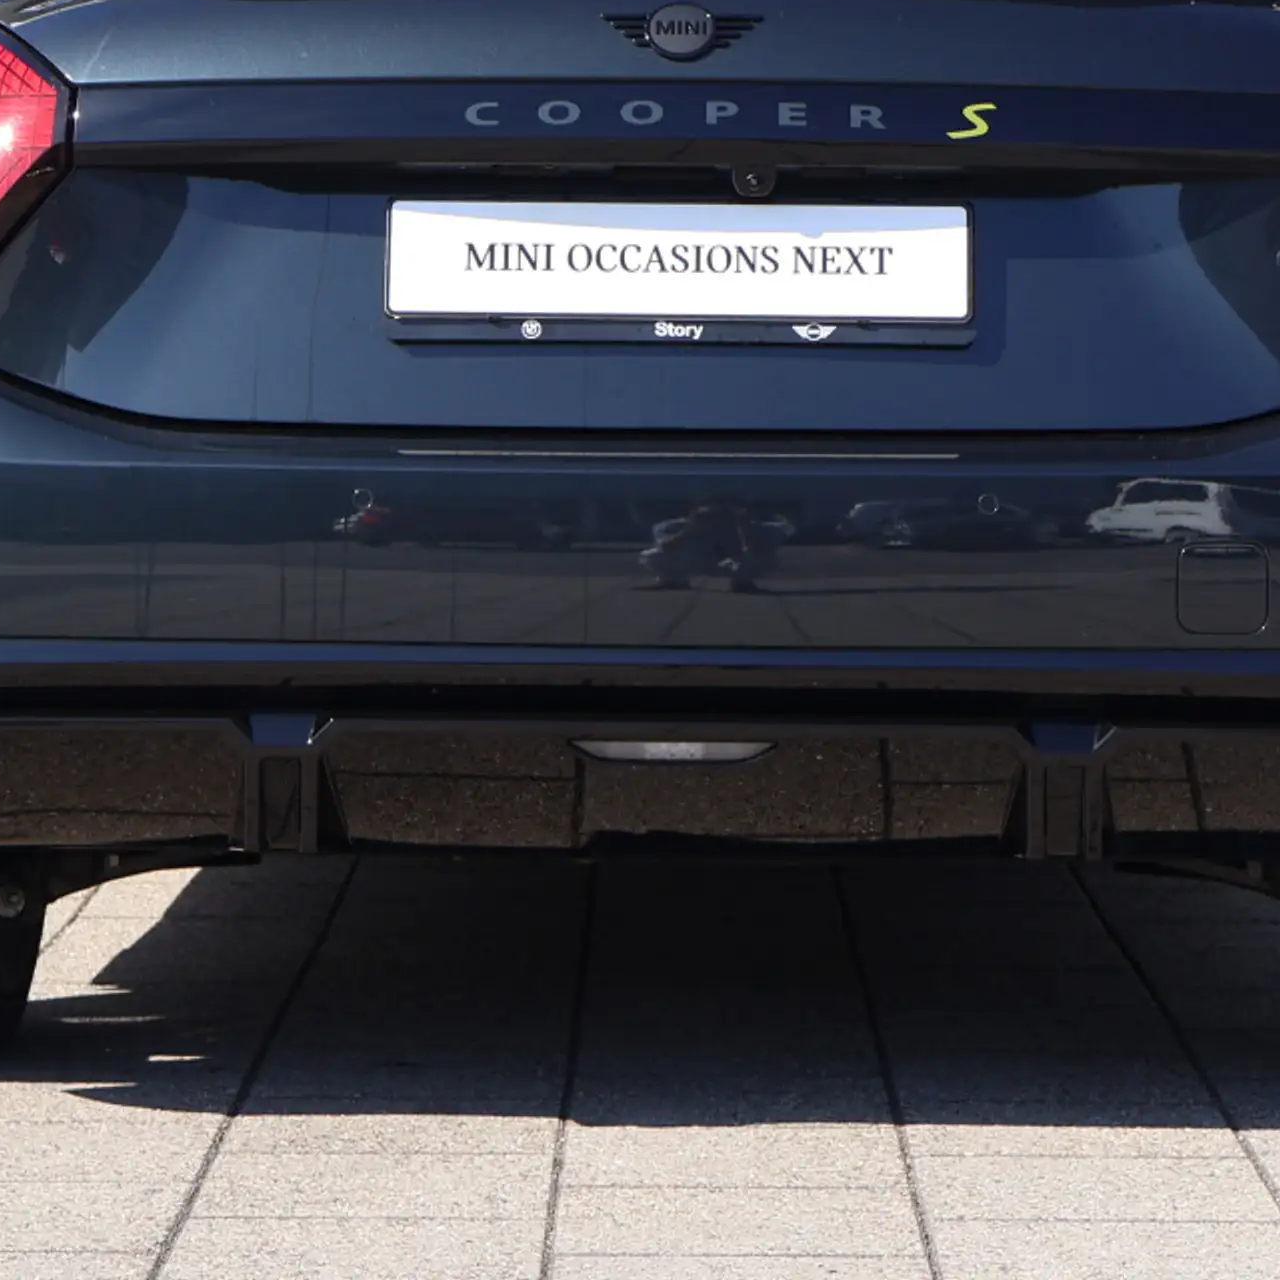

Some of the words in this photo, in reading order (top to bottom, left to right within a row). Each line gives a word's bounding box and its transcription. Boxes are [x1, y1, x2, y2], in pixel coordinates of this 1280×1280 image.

[655, 20, 708, 36] MINI
[464, 100, 887, 131] COOPER
[946, 103, 996, 139] S
[464, 242, 554, 272] MINI
[567, 242, 780, 274] OCCASIONS
[792, 245, 894, 276] NEXT
[653, 321, 704, 339] Story
